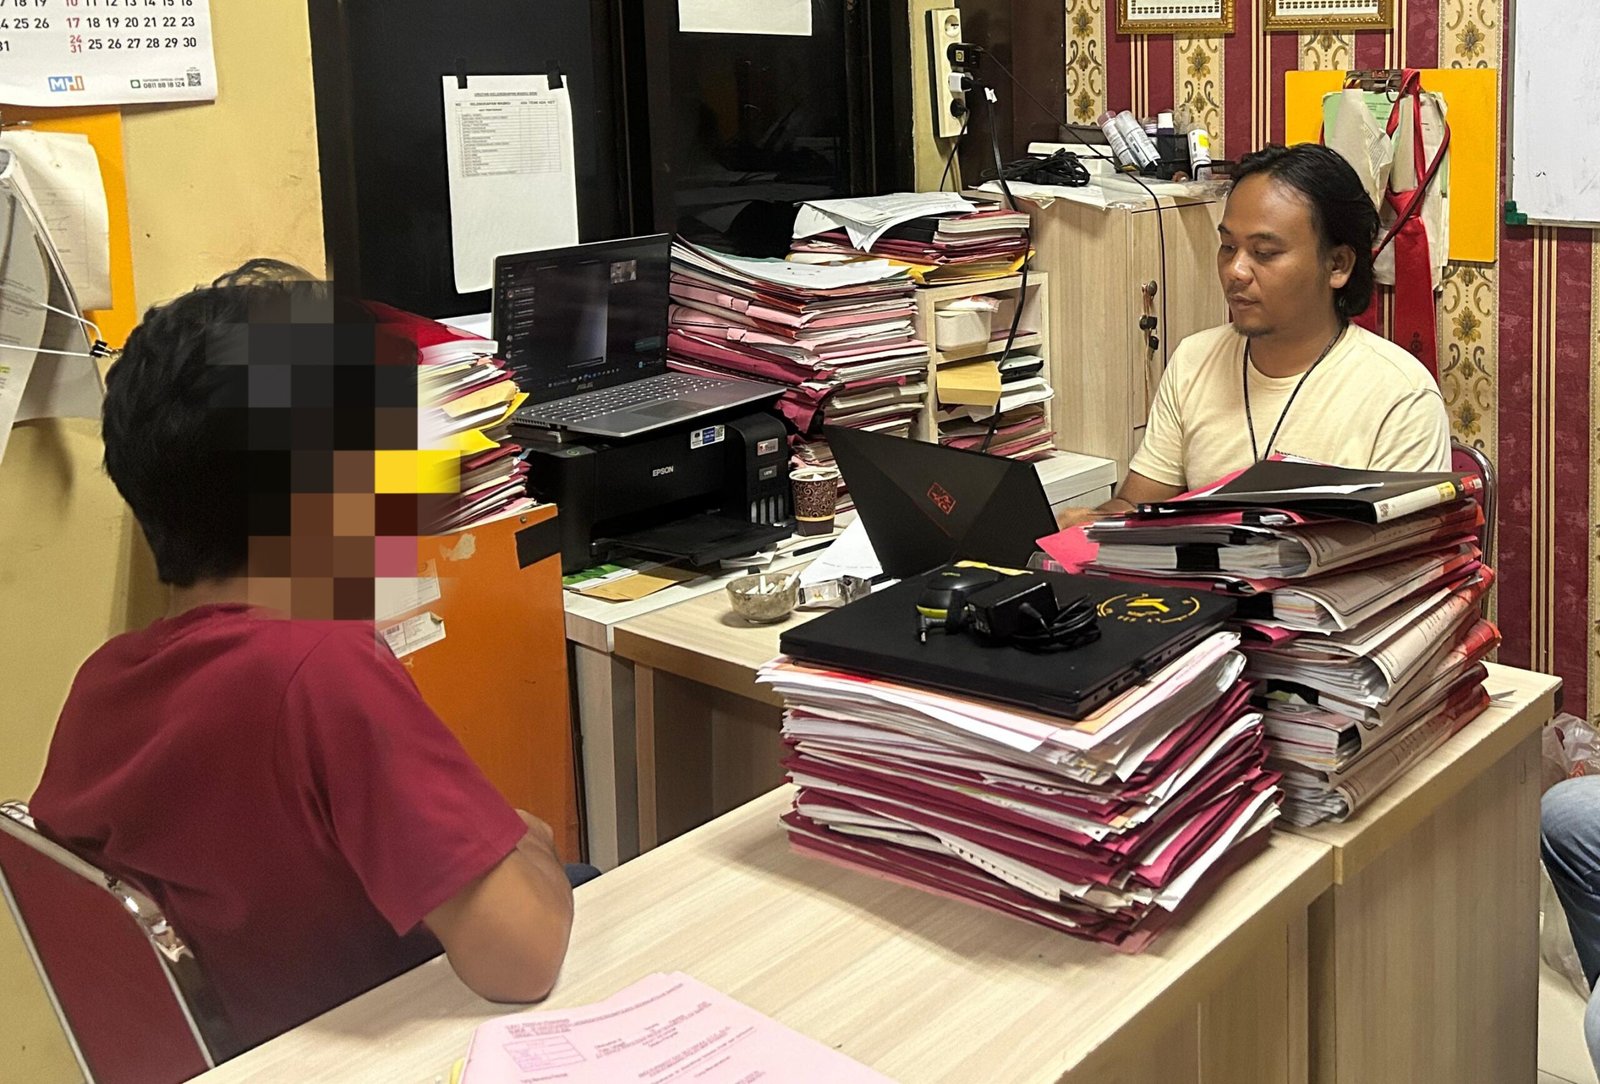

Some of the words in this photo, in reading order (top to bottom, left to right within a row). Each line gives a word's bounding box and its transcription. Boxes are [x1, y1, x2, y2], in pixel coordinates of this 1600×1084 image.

[13, 17, 29, 29] 25
[34, 17, 50, 29] 26
[66, 17, 80, 28] 17
[86, 17, 101, 28] 18
[105, 17, 120, 28] 19
[124, 17, 139, 28] 20
[143, 17, 157, 28] 21
[162, 16, 177, 28] 22
[181, 16, 195, 27] 23
[69, 34, 82, 44] 24
[87, 38, 103, 50] 25
[107, 38, 122, 49] 26
[127, 38, 141, 49] 27
[146, 37, 160, 48] 28
[164, 37, 178, 48] 29
[183, 37, 197, 48] 30
[70, 44, 82, 53] 31
[652, 465, 674, 477] EPSON
